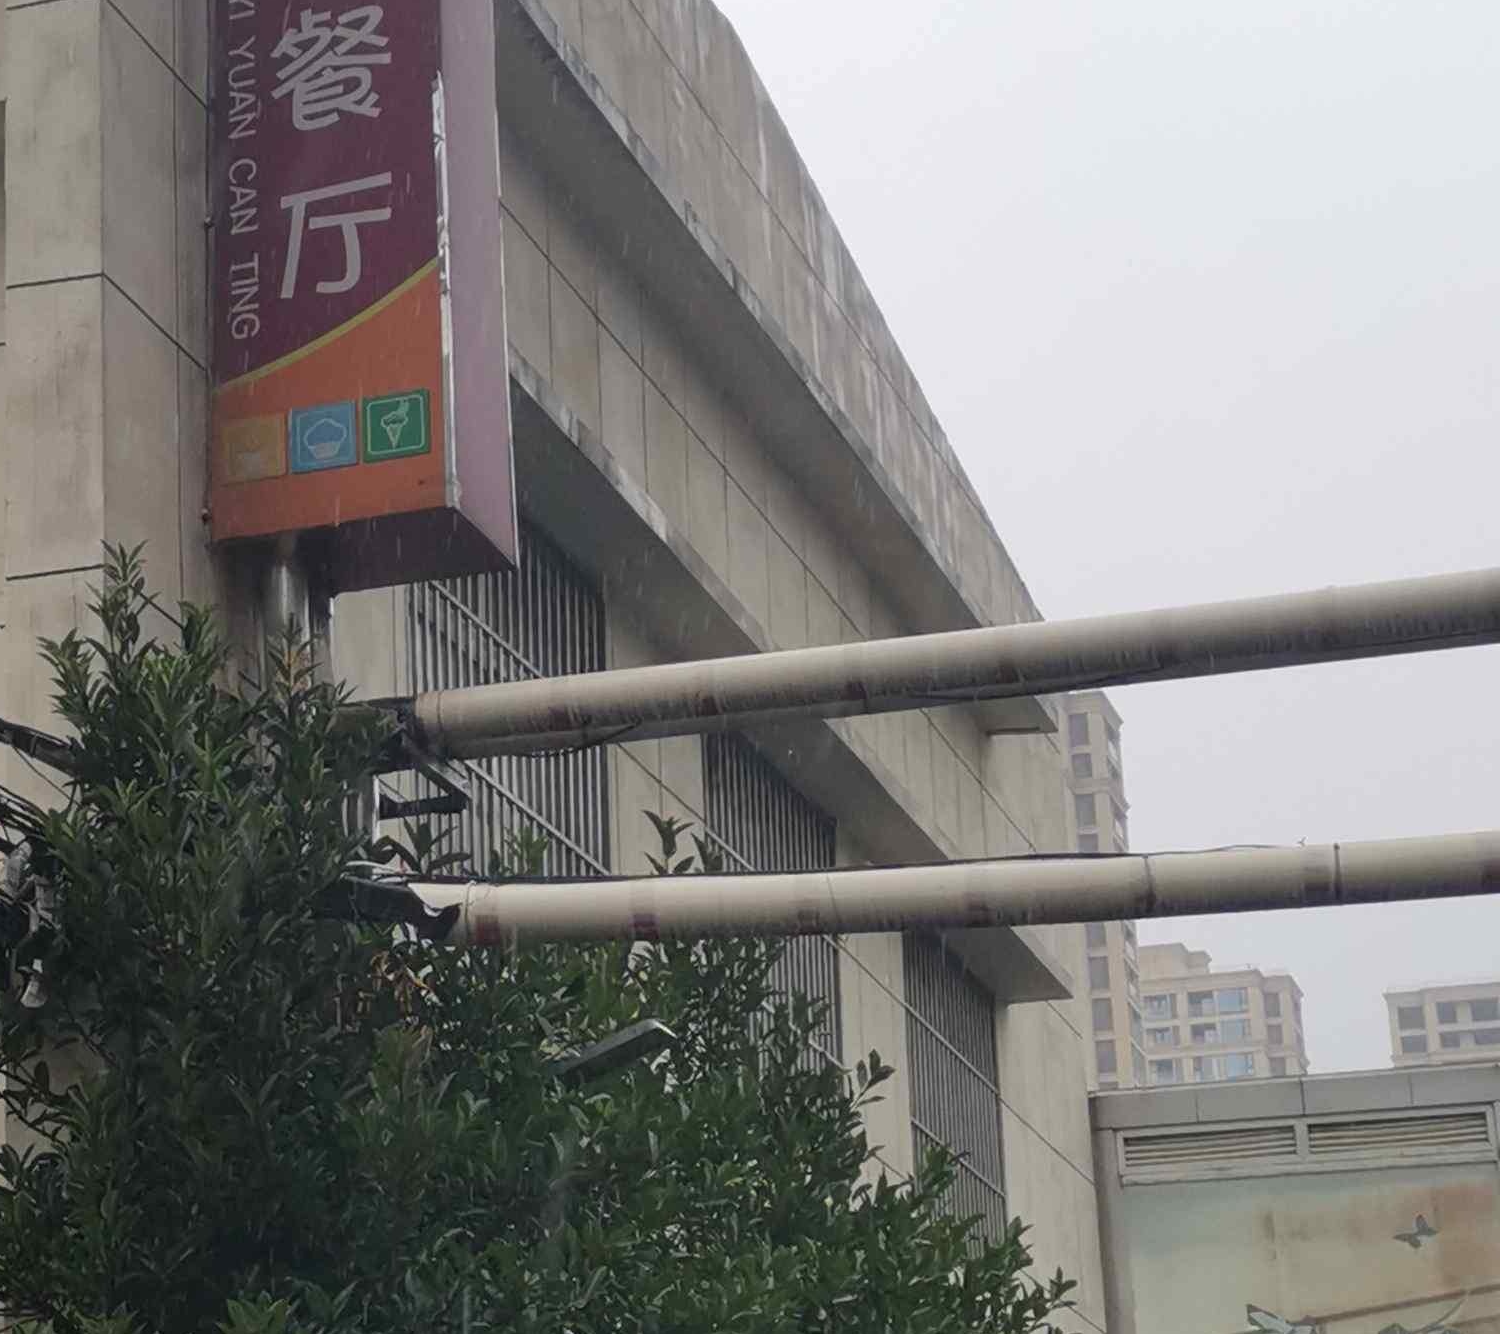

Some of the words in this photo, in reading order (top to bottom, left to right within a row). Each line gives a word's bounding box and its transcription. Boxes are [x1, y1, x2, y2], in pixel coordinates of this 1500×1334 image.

[228, 35, 257, 139] YUAN
[229, 159, 259, 235] CAN
[229, 252, 260, 340] TING
